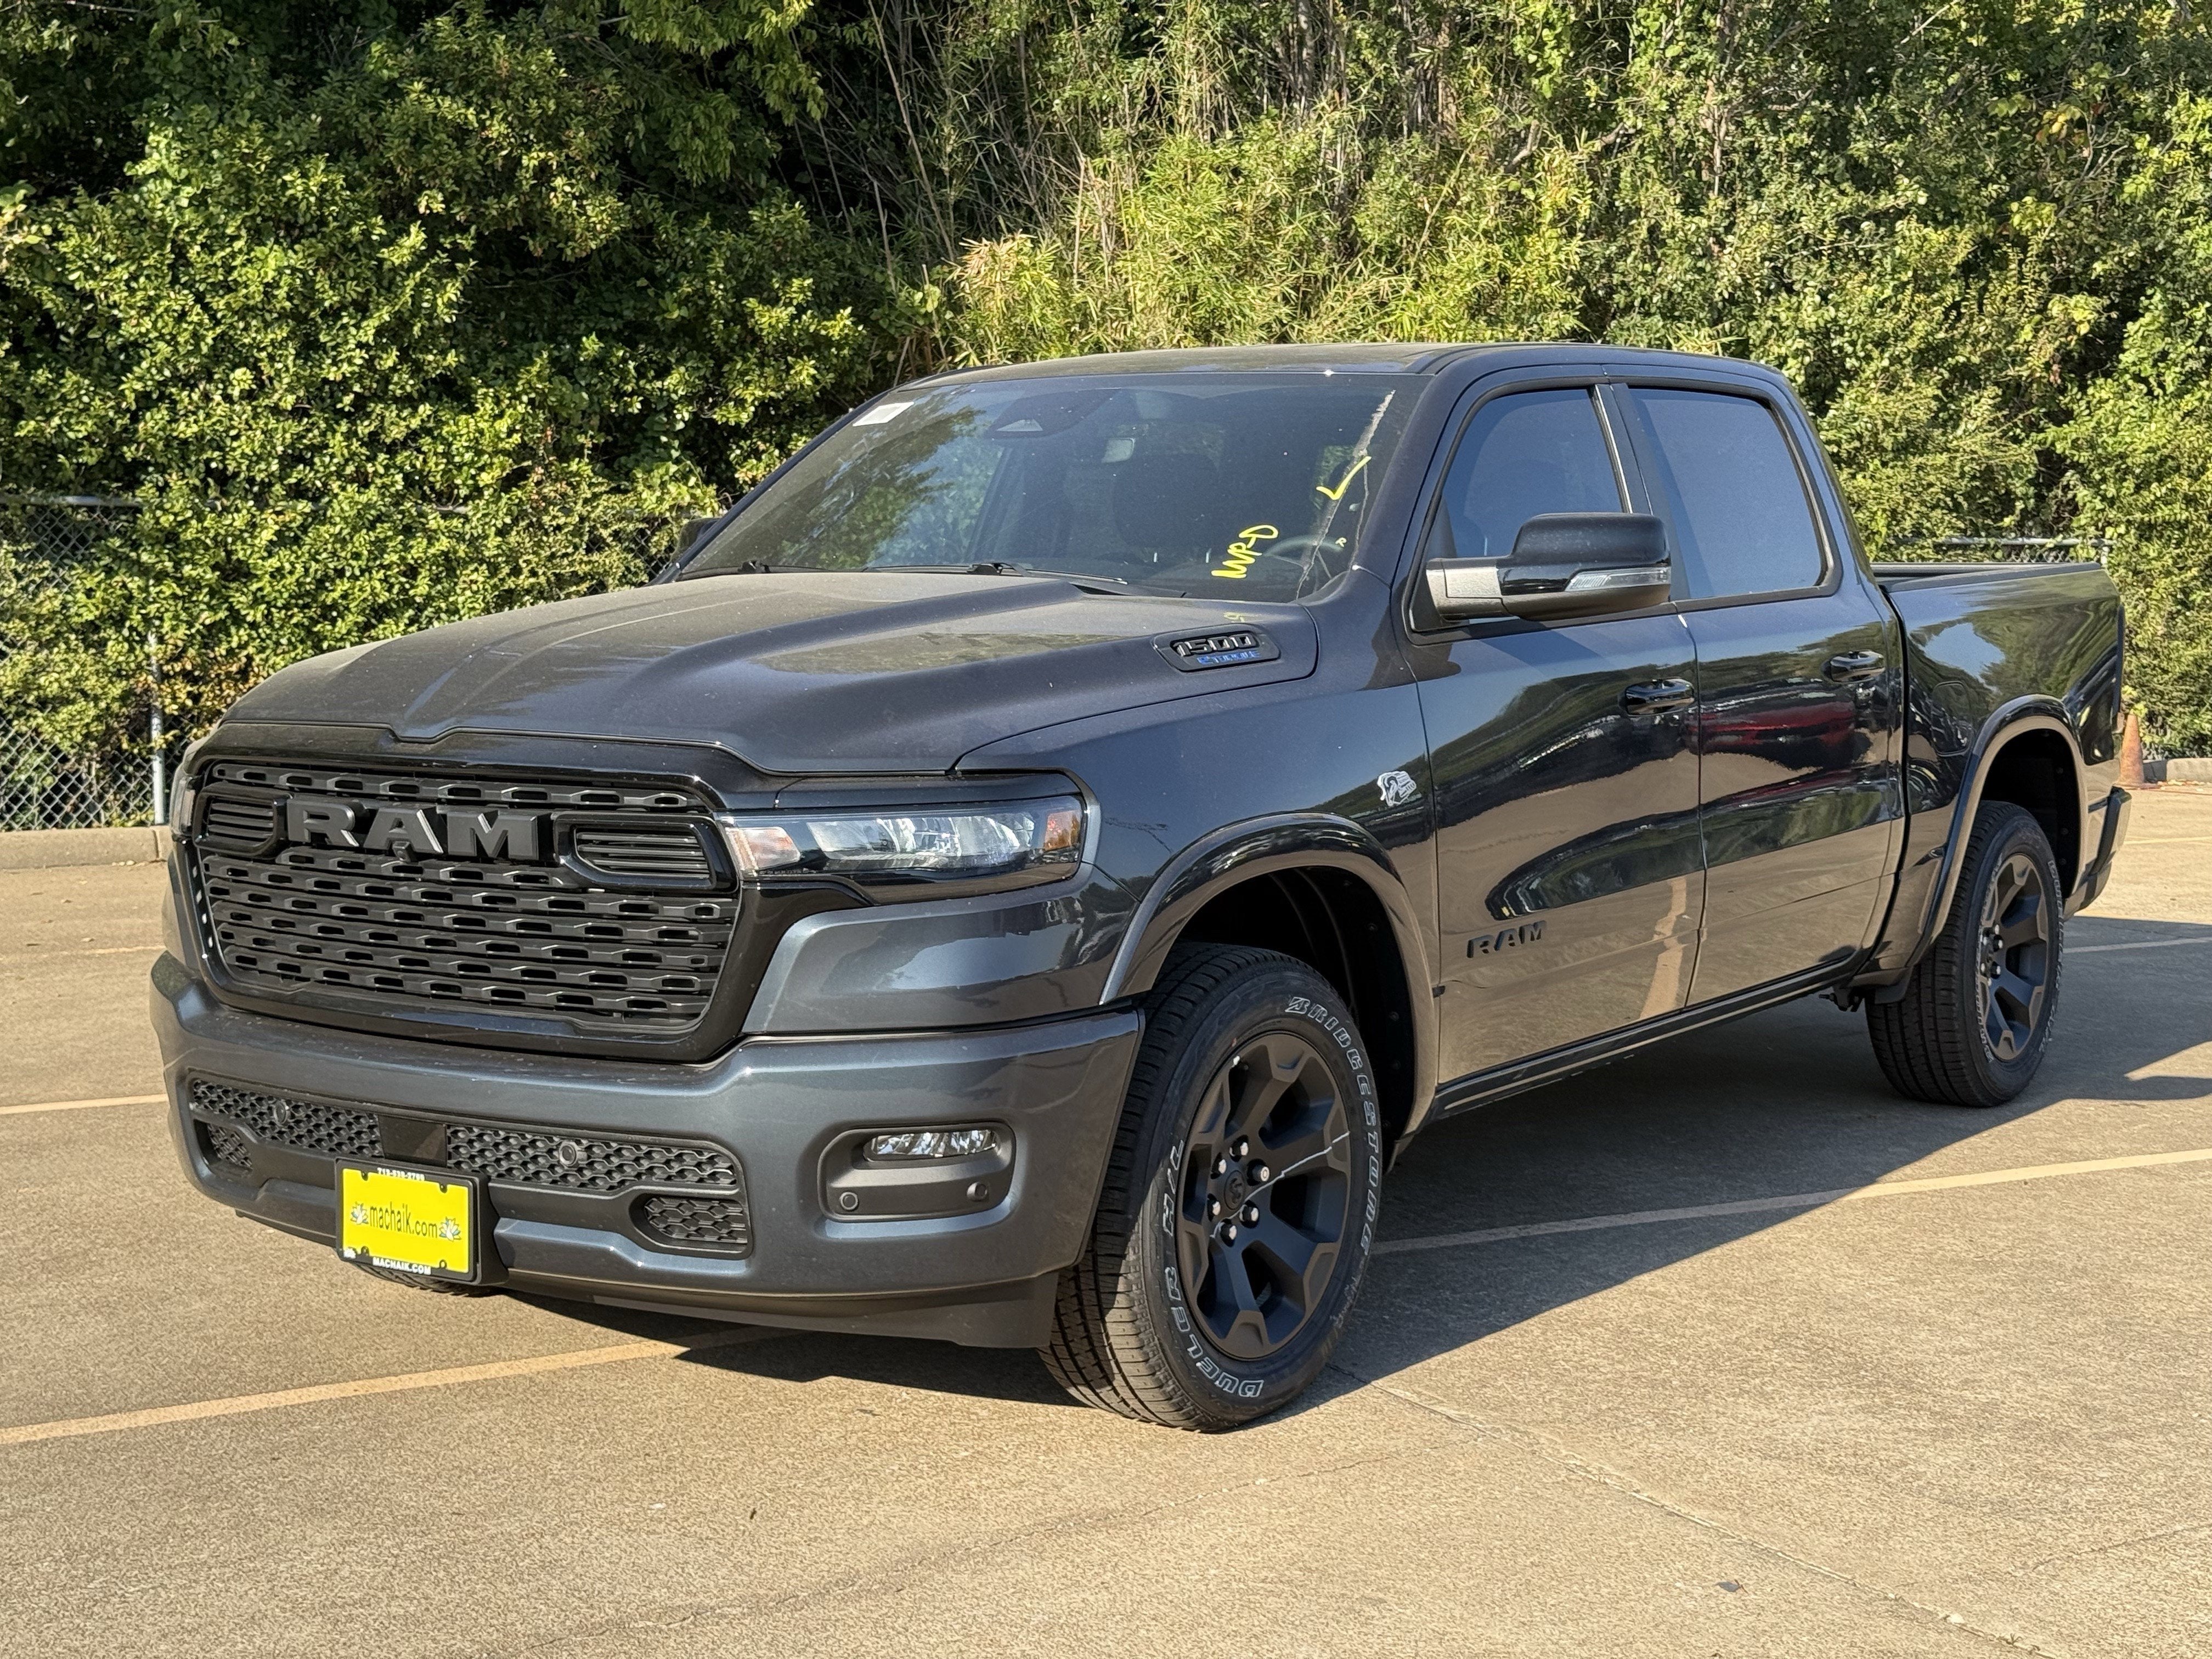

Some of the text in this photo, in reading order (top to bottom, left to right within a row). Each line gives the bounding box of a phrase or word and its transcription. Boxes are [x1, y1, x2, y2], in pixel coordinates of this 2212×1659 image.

[1173, 633, 1259, 657] 1500
[286, 797, 542, 861] RAM
[1466, 920, 1548, 958] RAM
[1284, 996, 1379, 1256] BRIDGESTONE
[370, 1201, 438, 1239] machaik.com
[372, 1256, 432, 1276] MACHAIK.COM
[1164, 1266, 1264, 1398] DUELER
